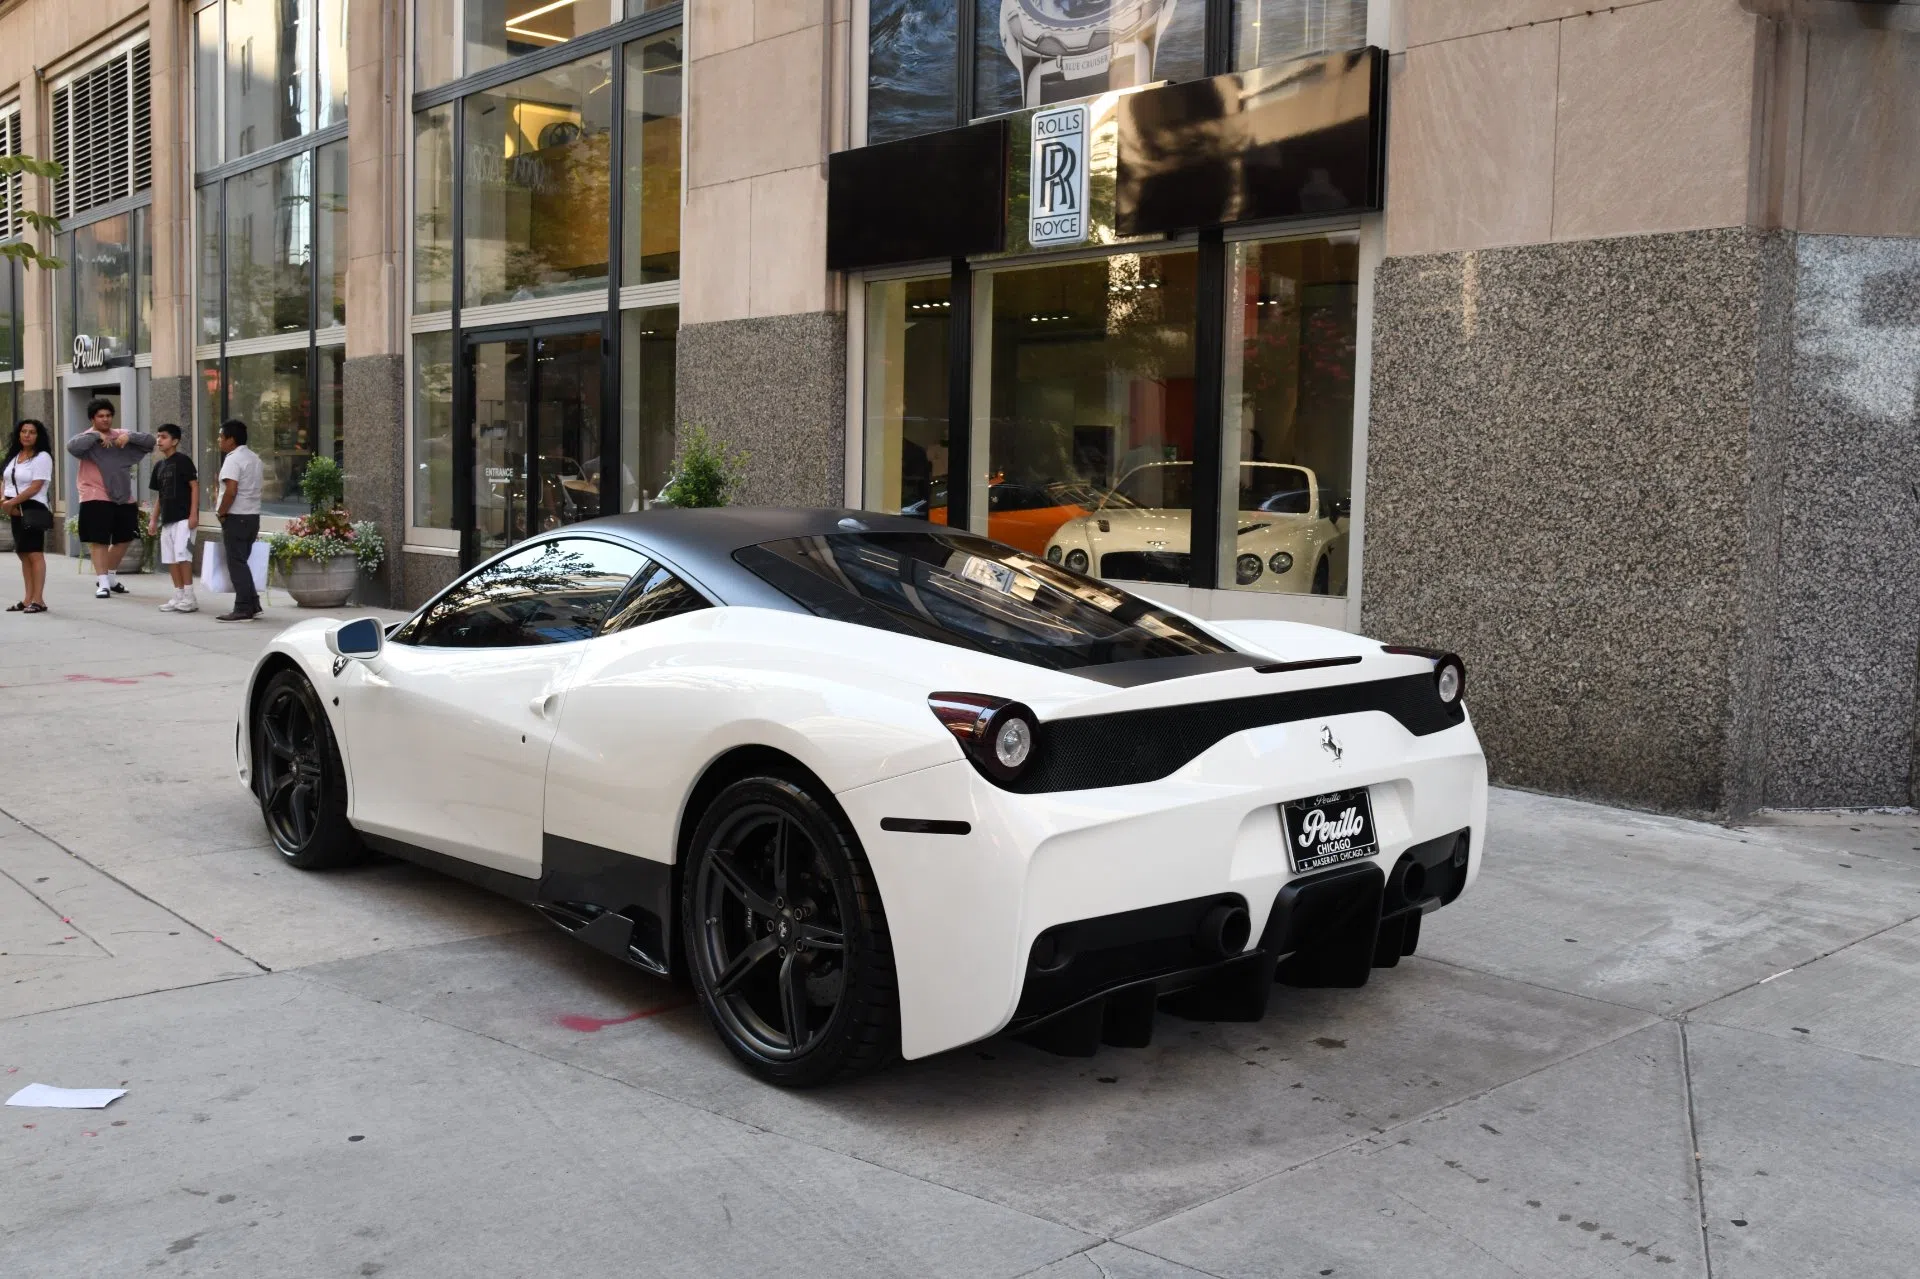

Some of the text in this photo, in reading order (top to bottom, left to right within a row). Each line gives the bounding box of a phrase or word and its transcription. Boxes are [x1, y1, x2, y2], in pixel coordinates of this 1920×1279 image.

[1065, 54, 1108, 71] BLUE CRUISER
[1037, 114, 1080, 136] ROLLS
[1035, 217, 1077, 237] ROYCE
[73, 334, 104, 369] Perillo
[485, 467, 514, 477] ENTRANCE
[1313, 792, 1342, 807] Perillo
[1298, 806, 1364, 848] Perillo
[1317, 838, 1351, 855] CHICAGO
[1312, 854, 1339, 868] MASERATI
[1340, 848, 1364, 861] CHICAGO
